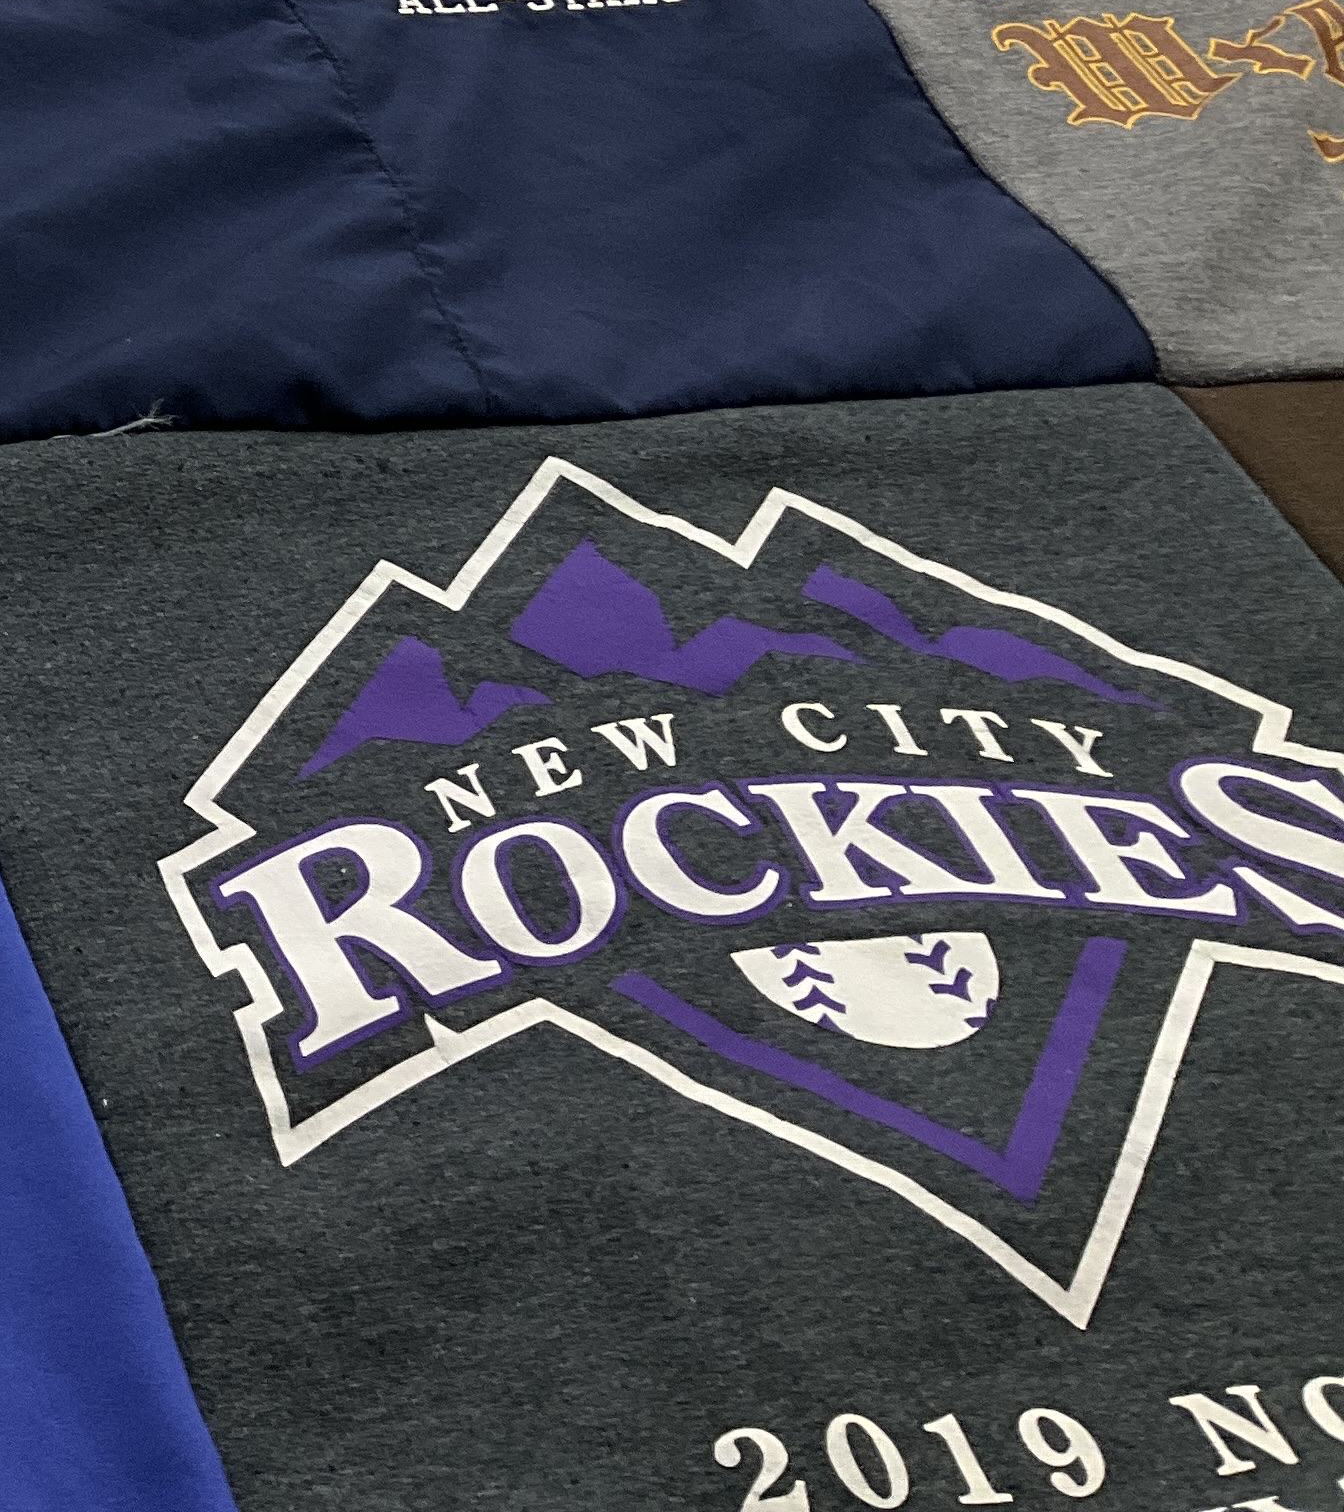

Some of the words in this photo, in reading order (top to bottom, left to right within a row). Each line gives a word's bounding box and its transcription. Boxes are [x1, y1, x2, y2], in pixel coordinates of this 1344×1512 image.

[424, 712, 680, 834] NEW
[779, 701, 1115, 779] CITY
[218, 758, 1344, 1061] ROCKIES
[714, 1405, 1108, 1512] 2019
